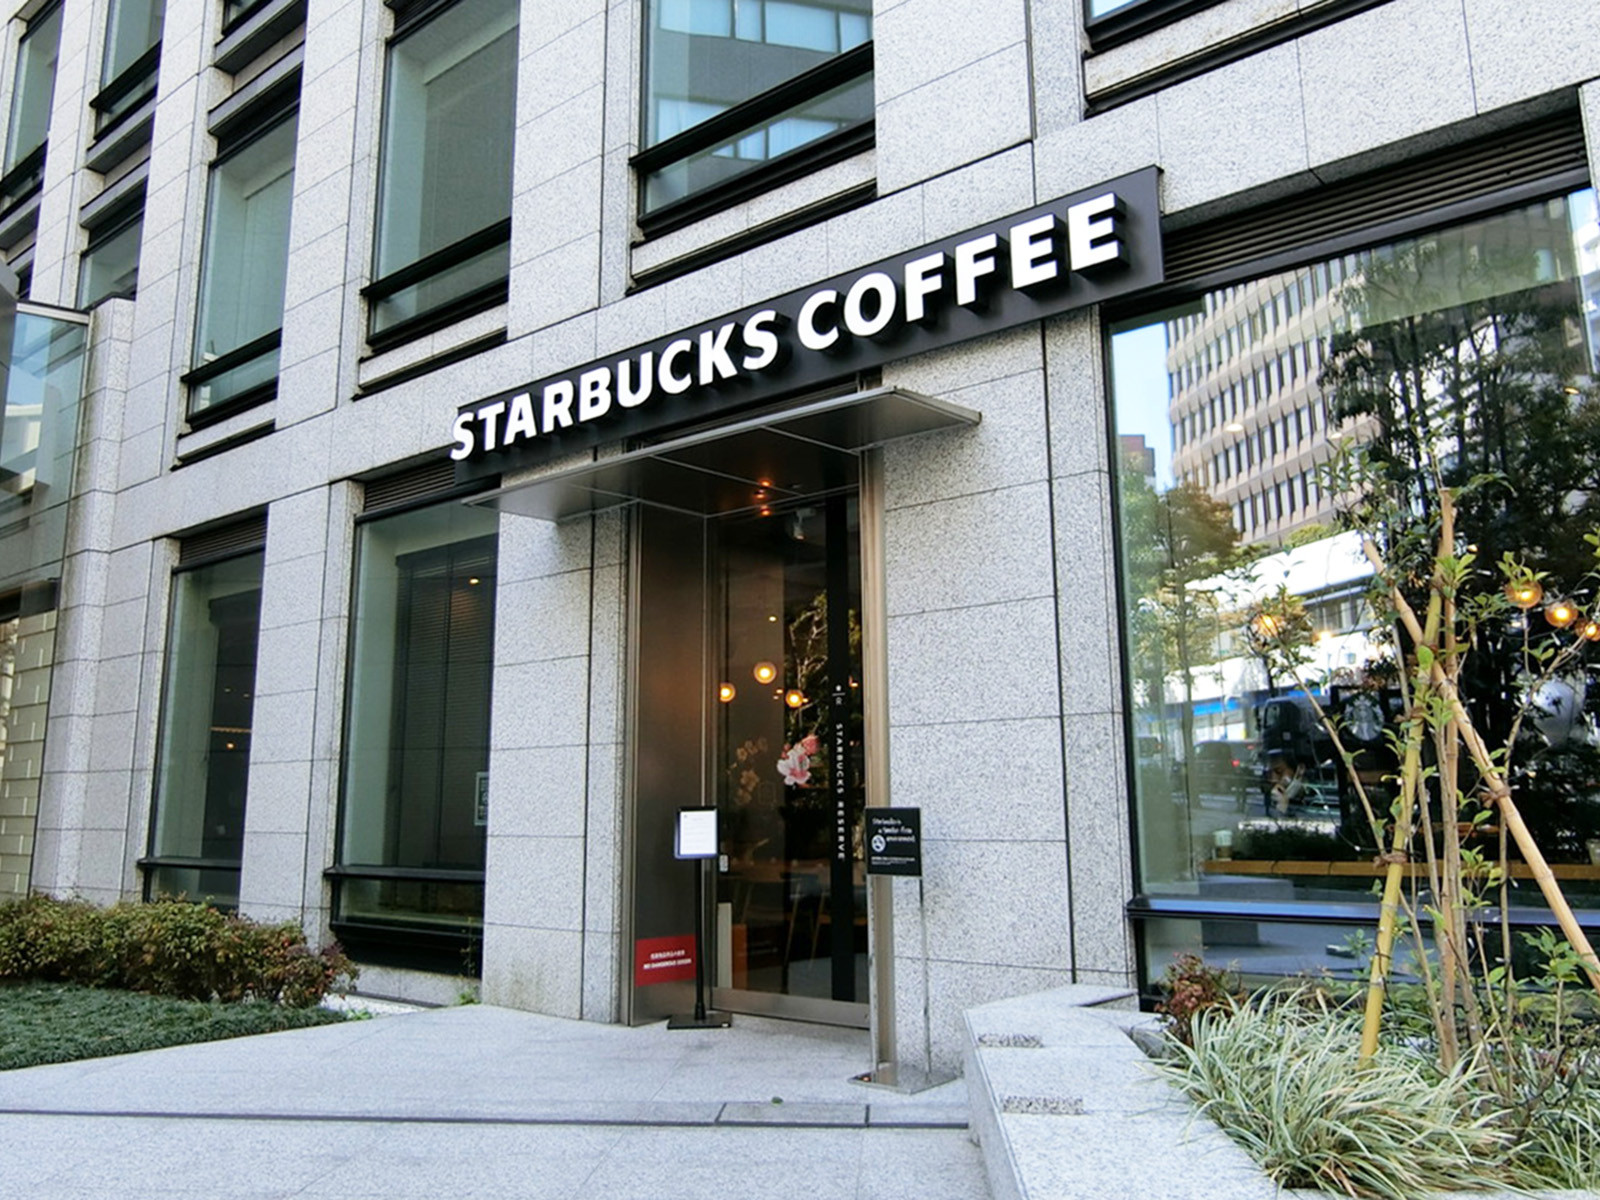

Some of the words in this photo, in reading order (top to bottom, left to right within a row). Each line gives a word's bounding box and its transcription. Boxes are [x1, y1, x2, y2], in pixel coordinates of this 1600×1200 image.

[450, 310, 778, 461] STARBUCKS
[797, 192, 1119, 350] COFFEE
[836, 723, 844, 794] STARBUCKS
[837, 801, 845, 860] RESERVE
